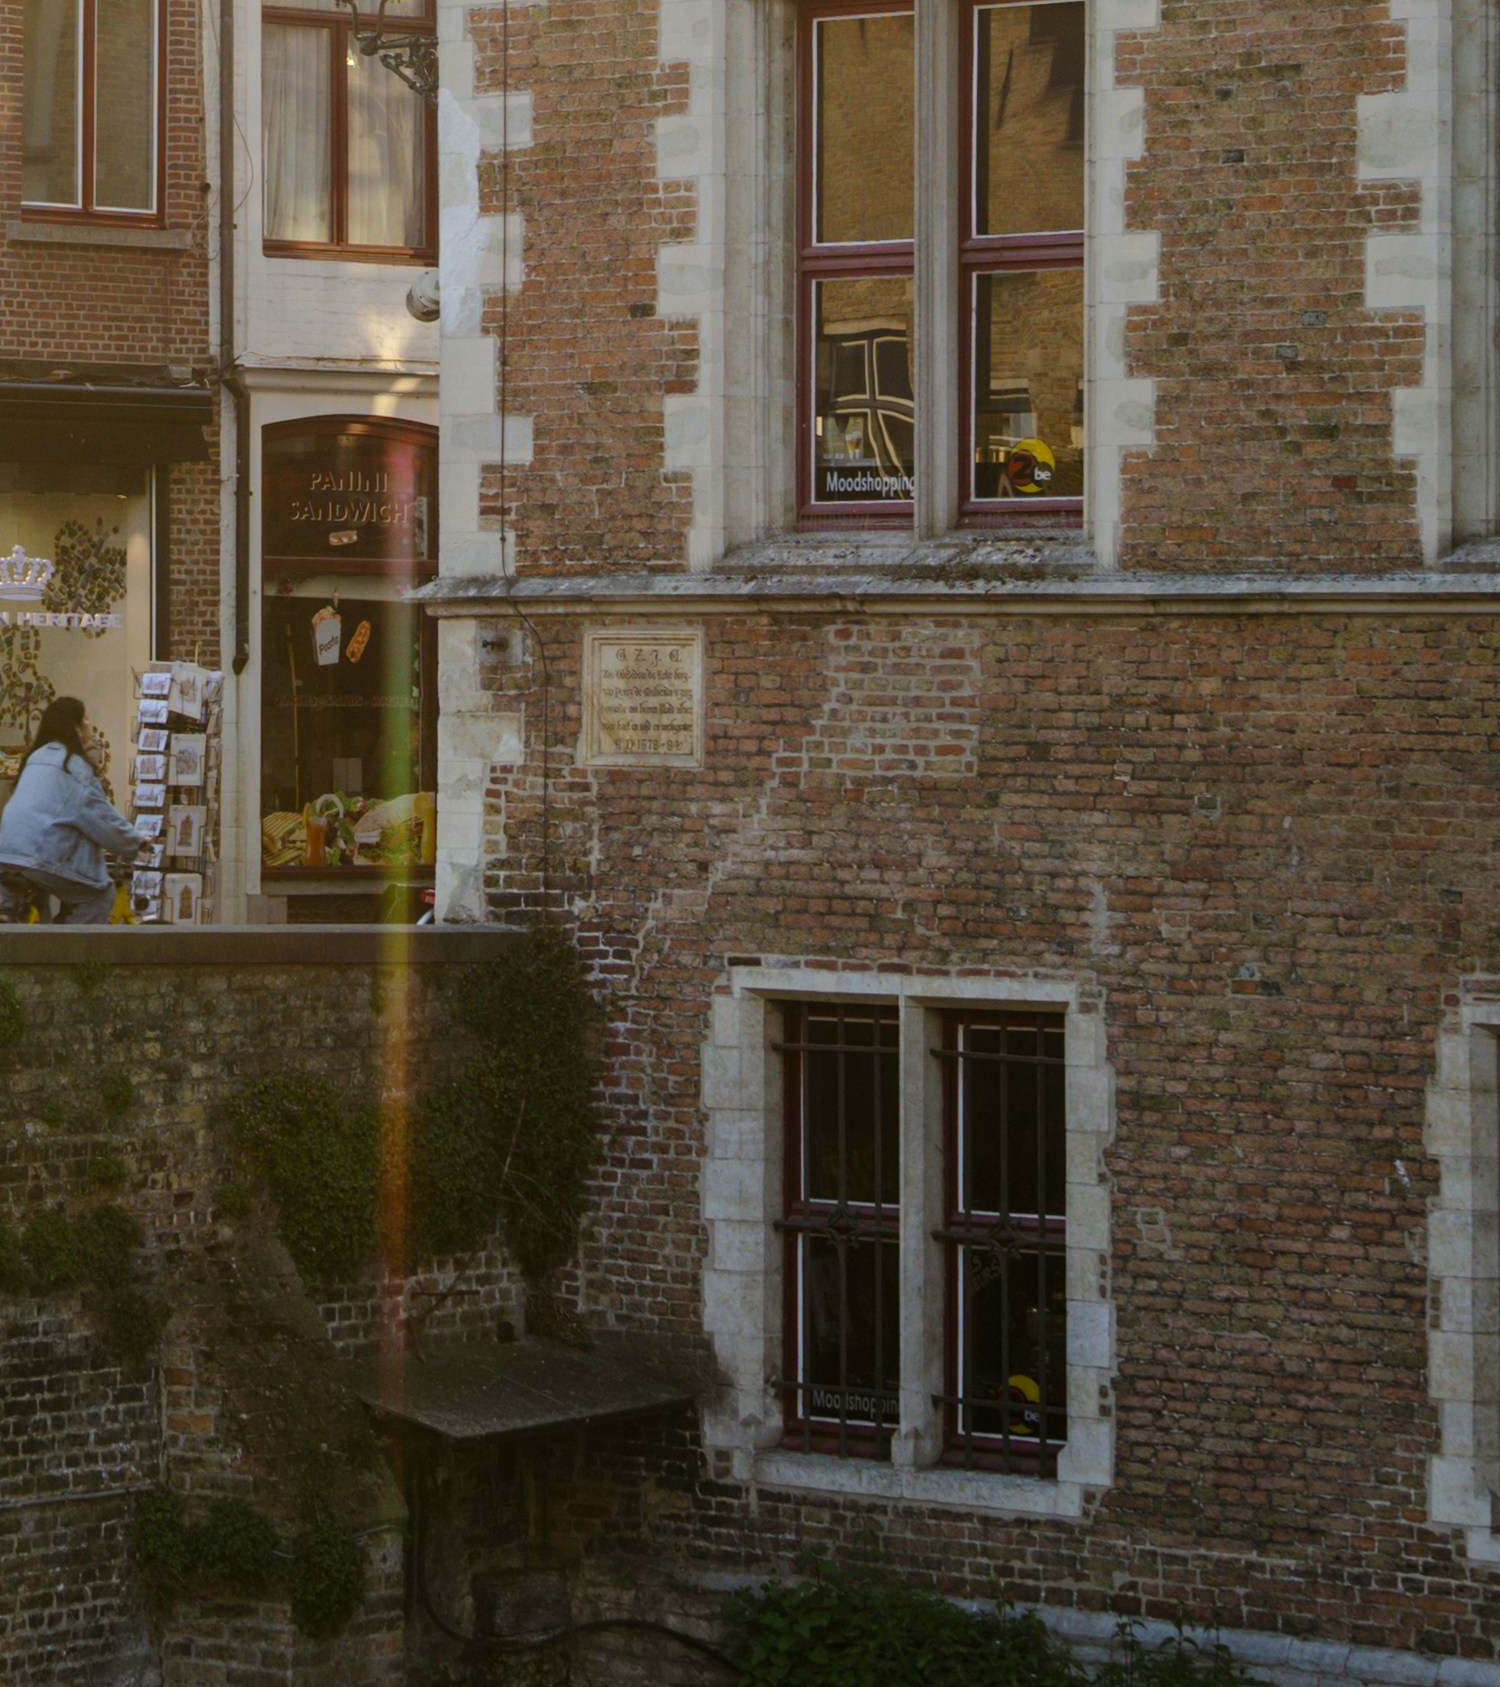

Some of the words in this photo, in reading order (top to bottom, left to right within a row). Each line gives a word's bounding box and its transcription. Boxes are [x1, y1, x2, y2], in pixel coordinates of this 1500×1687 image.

[309, 471, 388, 492] PANINI
[289, 501, 409, 523] SANDWICH
[16, 611, 122, 629] HERITAGE
